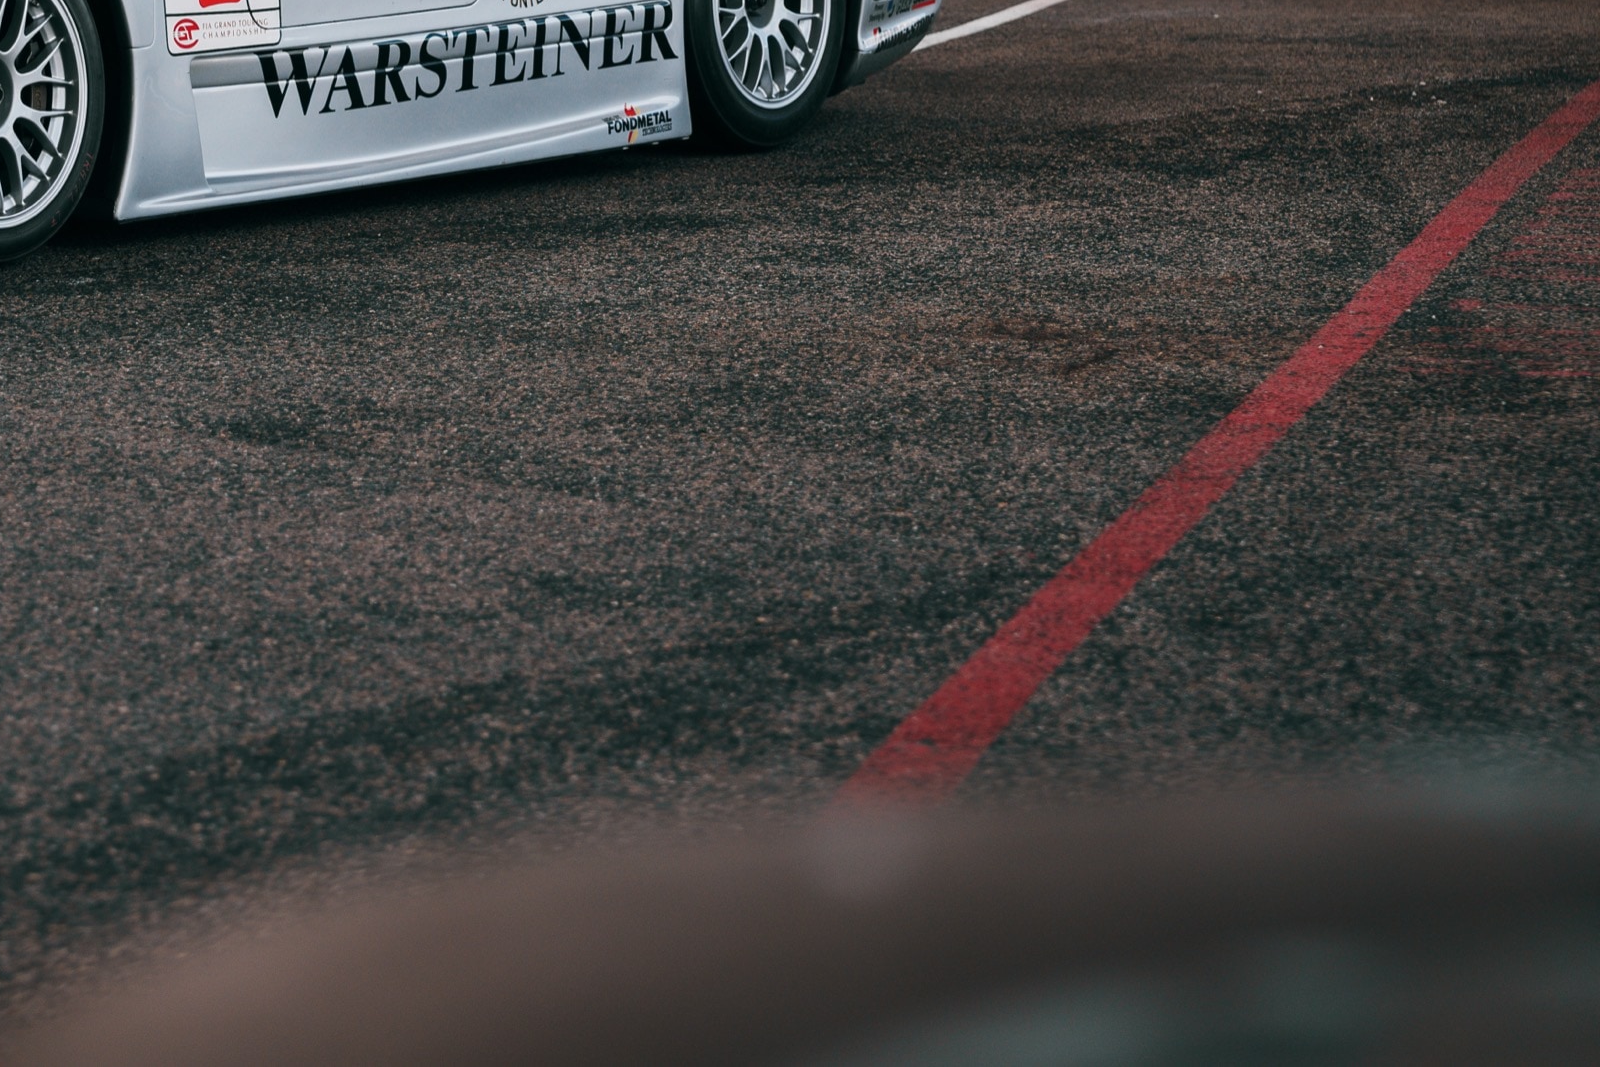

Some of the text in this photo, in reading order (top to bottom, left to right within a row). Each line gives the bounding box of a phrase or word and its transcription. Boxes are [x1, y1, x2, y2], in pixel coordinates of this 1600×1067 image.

[202, 17, 269, 30] FIA GRAND TOURING
[253, 2, 679, 119] WARSTEINER
[608, 110, 672, 134] FONDMETAL
